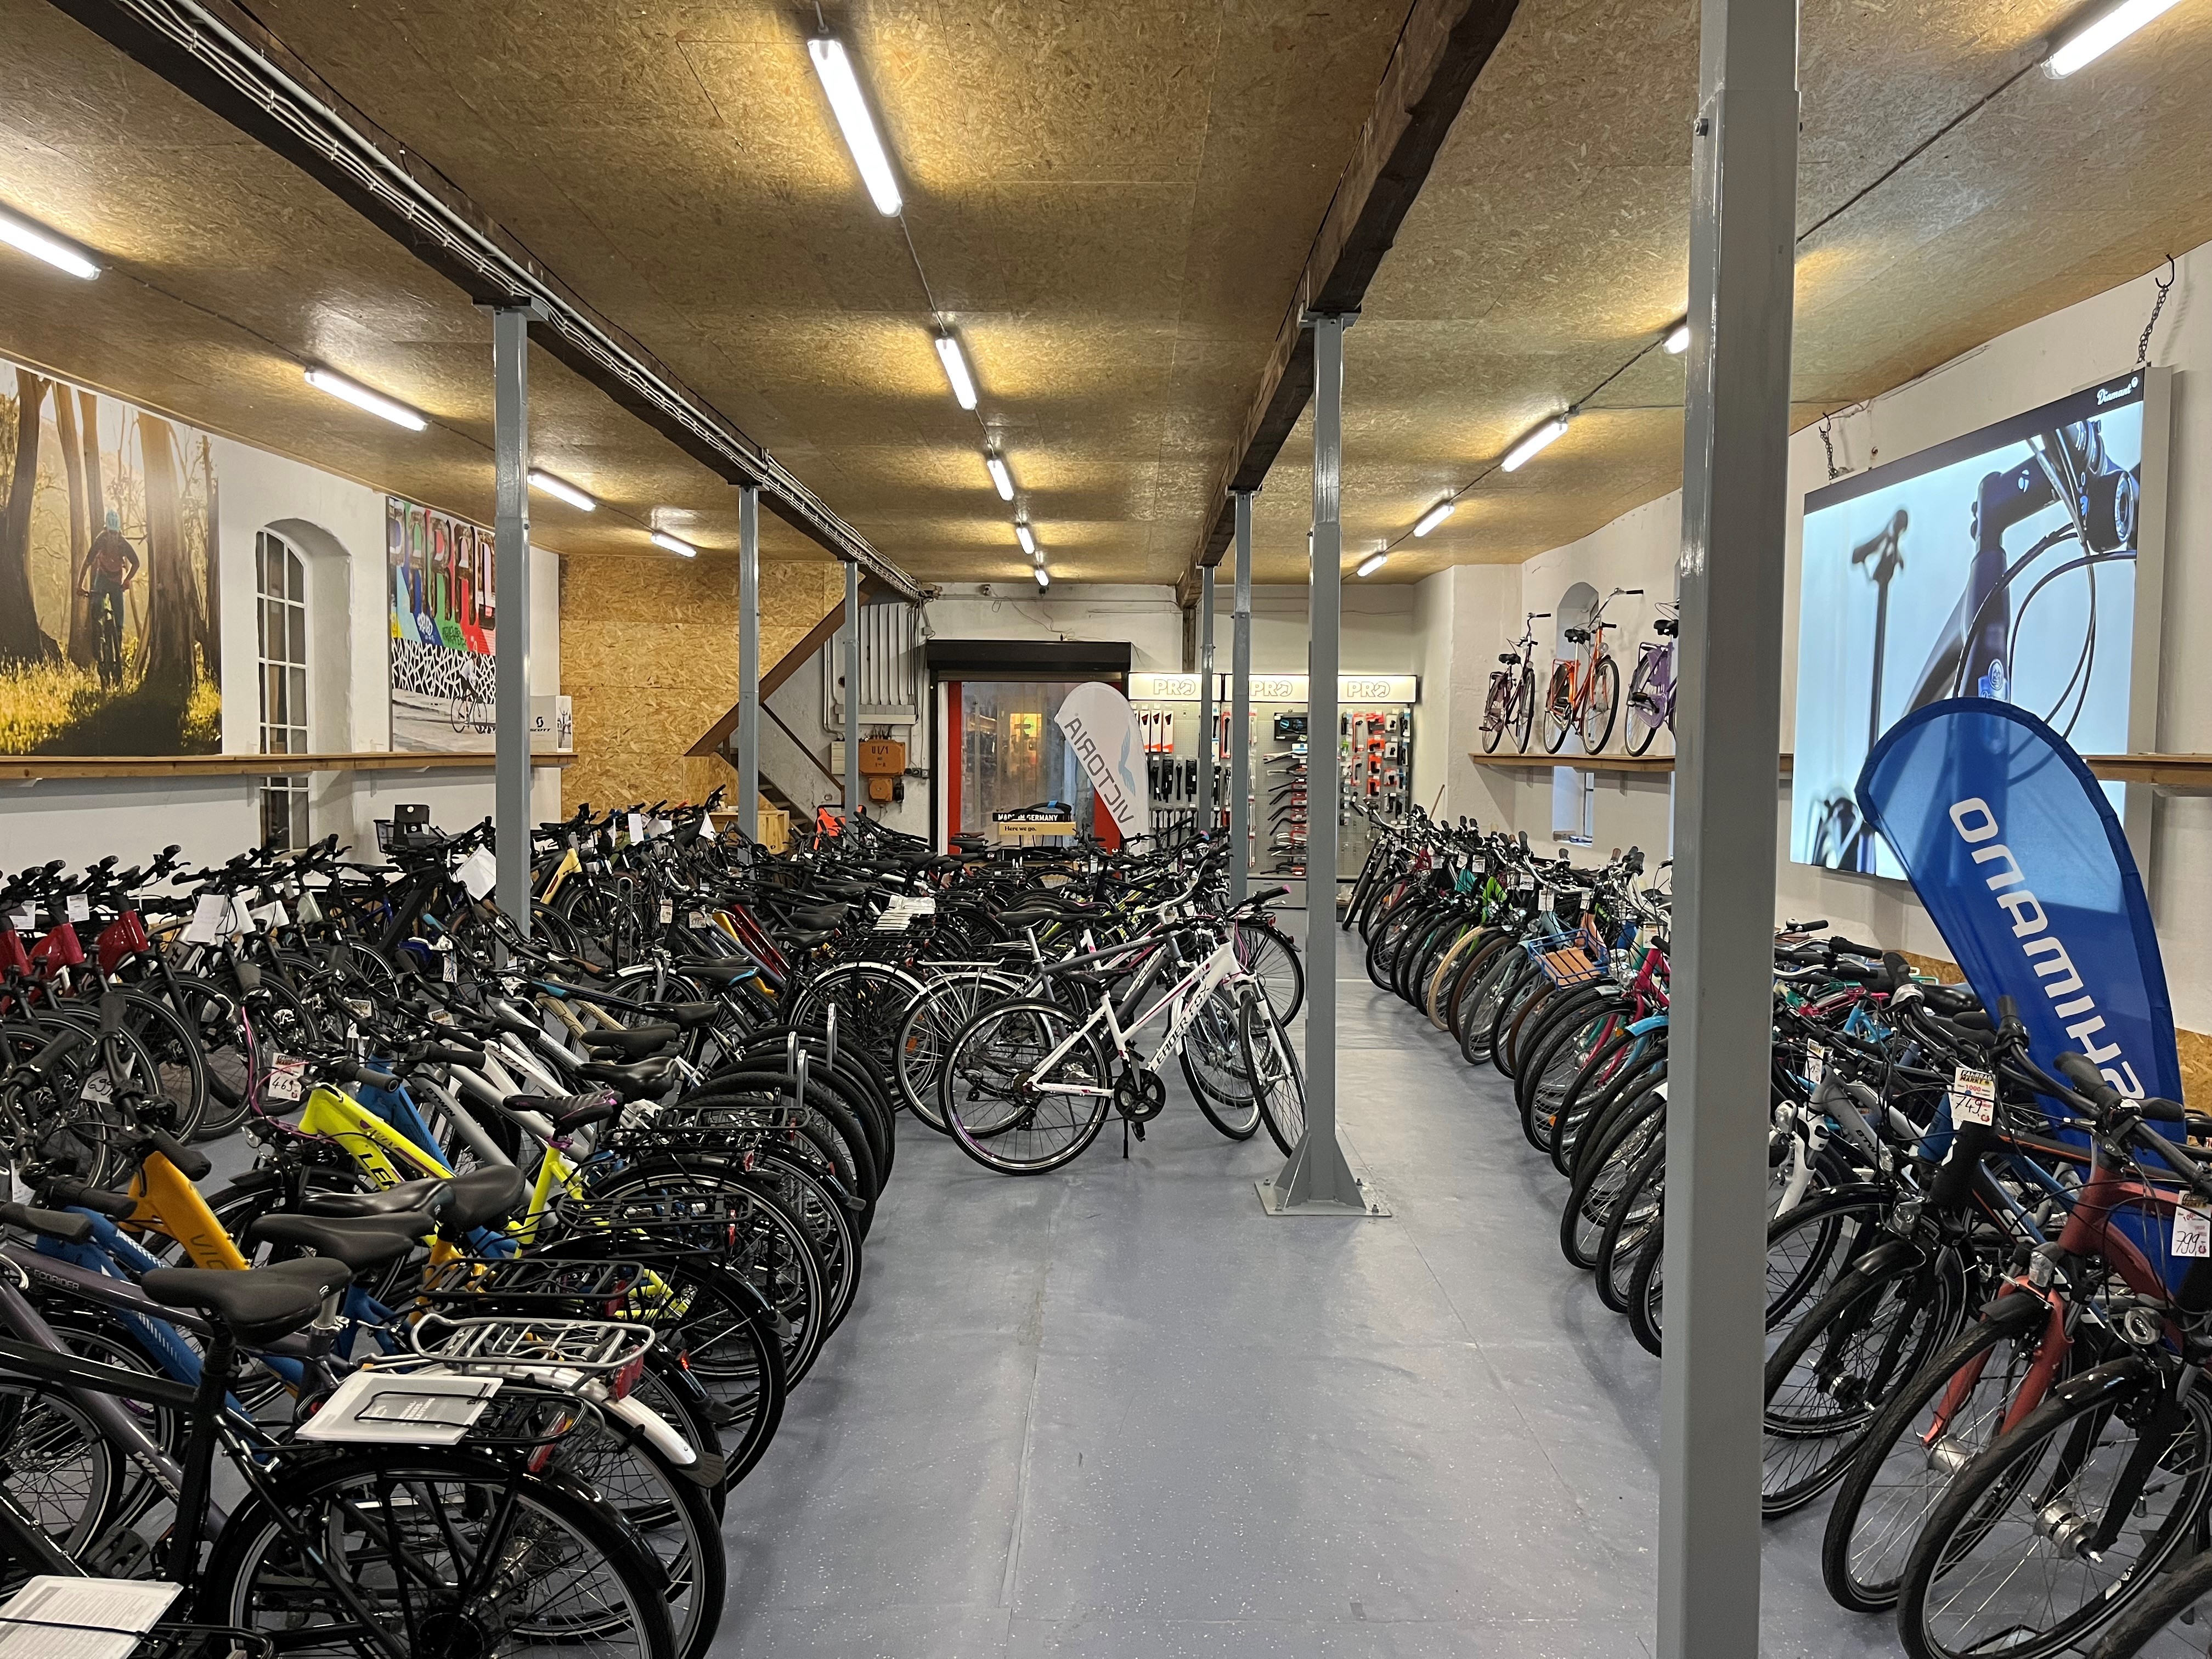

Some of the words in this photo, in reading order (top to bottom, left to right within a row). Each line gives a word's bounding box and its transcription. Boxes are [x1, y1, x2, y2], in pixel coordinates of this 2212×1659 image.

[1153, 679, 1195, 695] PRO
[1250, 680, 1293, 697] PRO
[1347, 681, 1390, 697] PRO
[1150, 1016, 1188, 1073] LEADER
